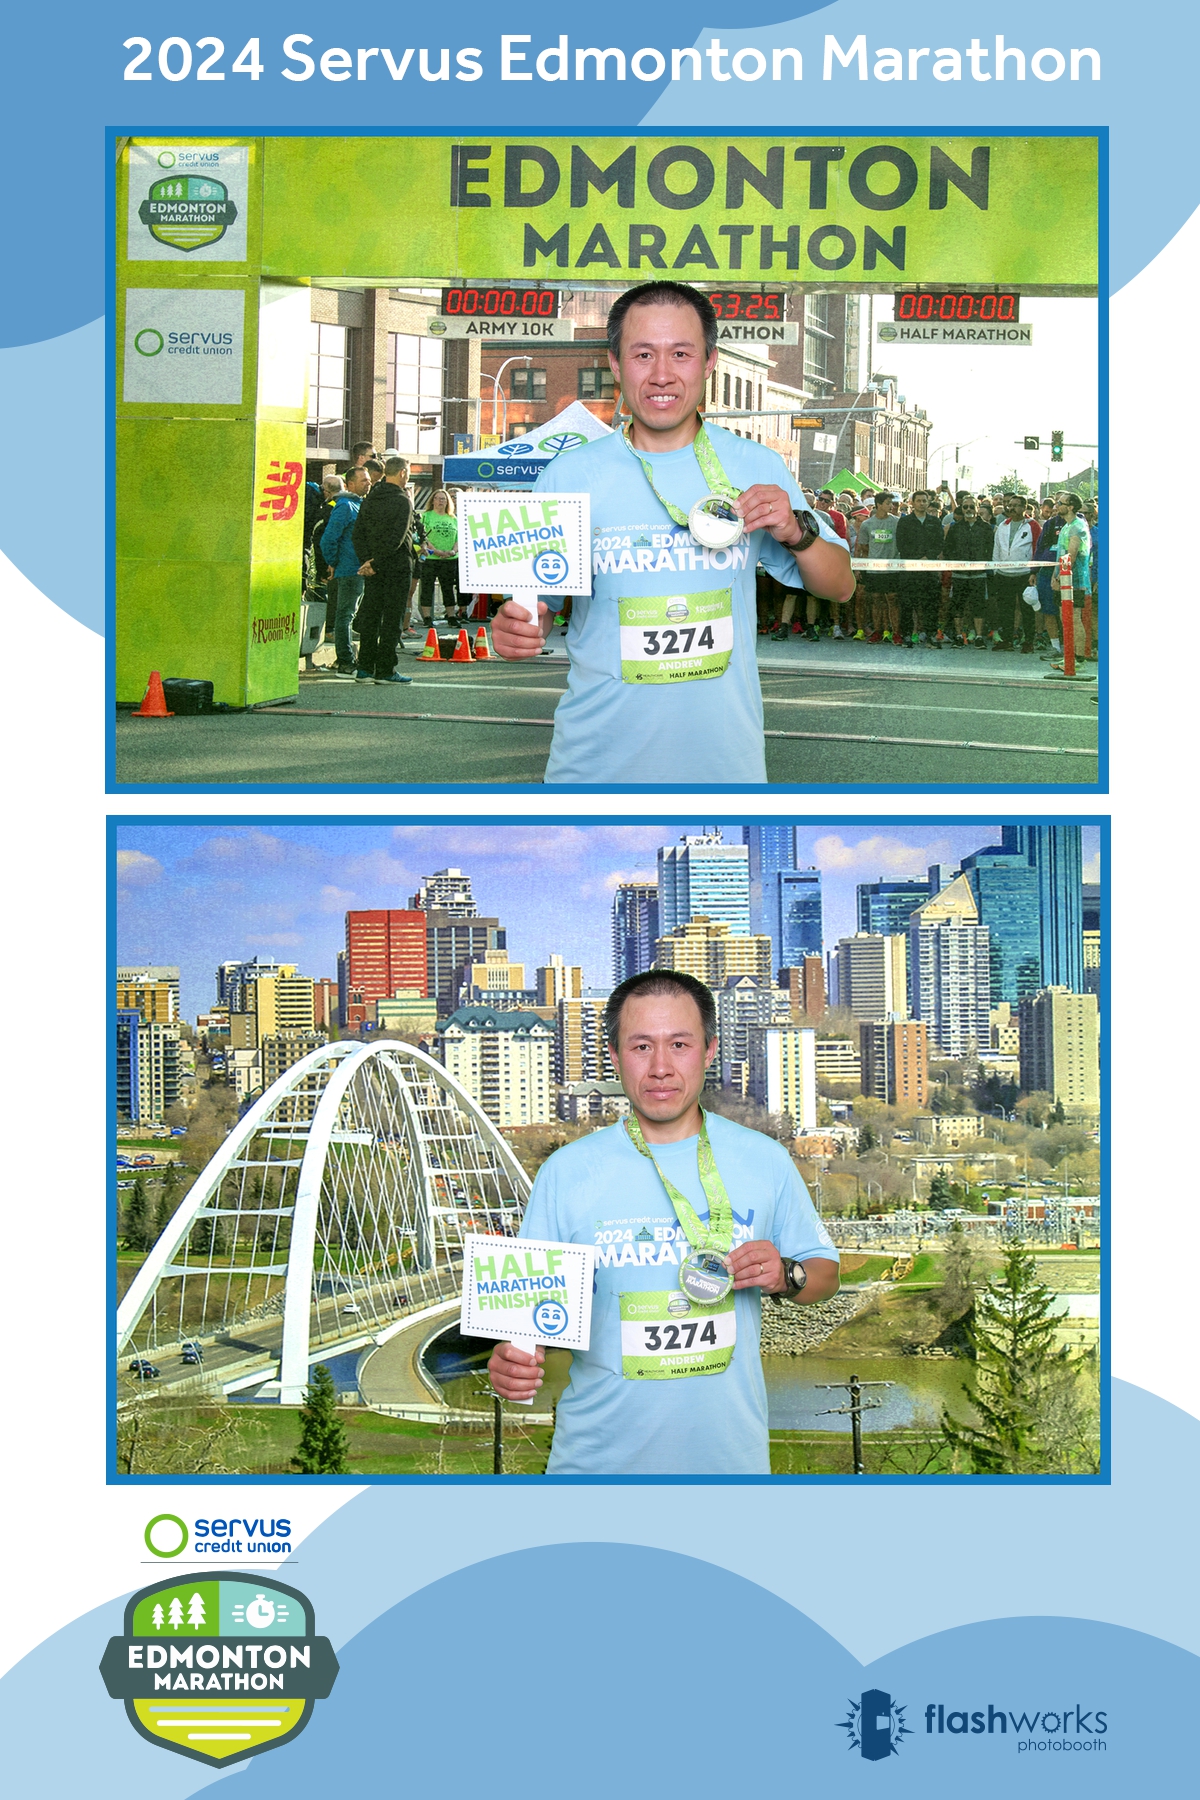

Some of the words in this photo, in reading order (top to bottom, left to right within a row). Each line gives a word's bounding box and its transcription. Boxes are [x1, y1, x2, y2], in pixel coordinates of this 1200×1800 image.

[178, 151, 219, 161] servus
[449, 144, 990, 211] EDMONTON
[150, 203, 227, 214] EDMONTON
[160, 214, 215, 222] MARATHON
[523, 223, 906, 271] MARATHON
[466, 321, 518, 336] ARMY
[521, 322, 554, 336] 10K
[718, 326, 784, 340] ATHON
[900, 328, 939, 339] HALF
[943, 328, 1031, 341] MARATHON
[168, 331, 233, 345] servus
[168, 345, 200, 355] credit
[203, 345, 233, 355] union
[496, 465, 544, 475] servus
[467, 499, 559, 539] HALF
[472, 525, 564, 551] MARATHON
[593, 535, 632, 551] 2024
[652, 532, 750, 549] EDMON
[475, 539, 568, 568] FINISHER!
[593, 548, 749, 575] MARATHON
[643, 625, 714, 656] 3274
[658, 659, 703, 671] ANDREW
[687, 666, 724, 677] MARATHON
[603, 1218, 628, 1227] servus
[630, 1216, 650, 1224] credit
[594, 1229, 634, 1245] 2024
[654, 1224, 754, 1242] EDMON
[474, 1249, 563, 1281] HALF
[477, 1275, 566, 1294] MARATHON
[478, 1289, 569, 1311] FINISHER!
[644, 1320, 717, 1351] 3274
[660, 1354, 705, 1366] ANDREW
[689, 1361, 726, 1373] MARATHON
